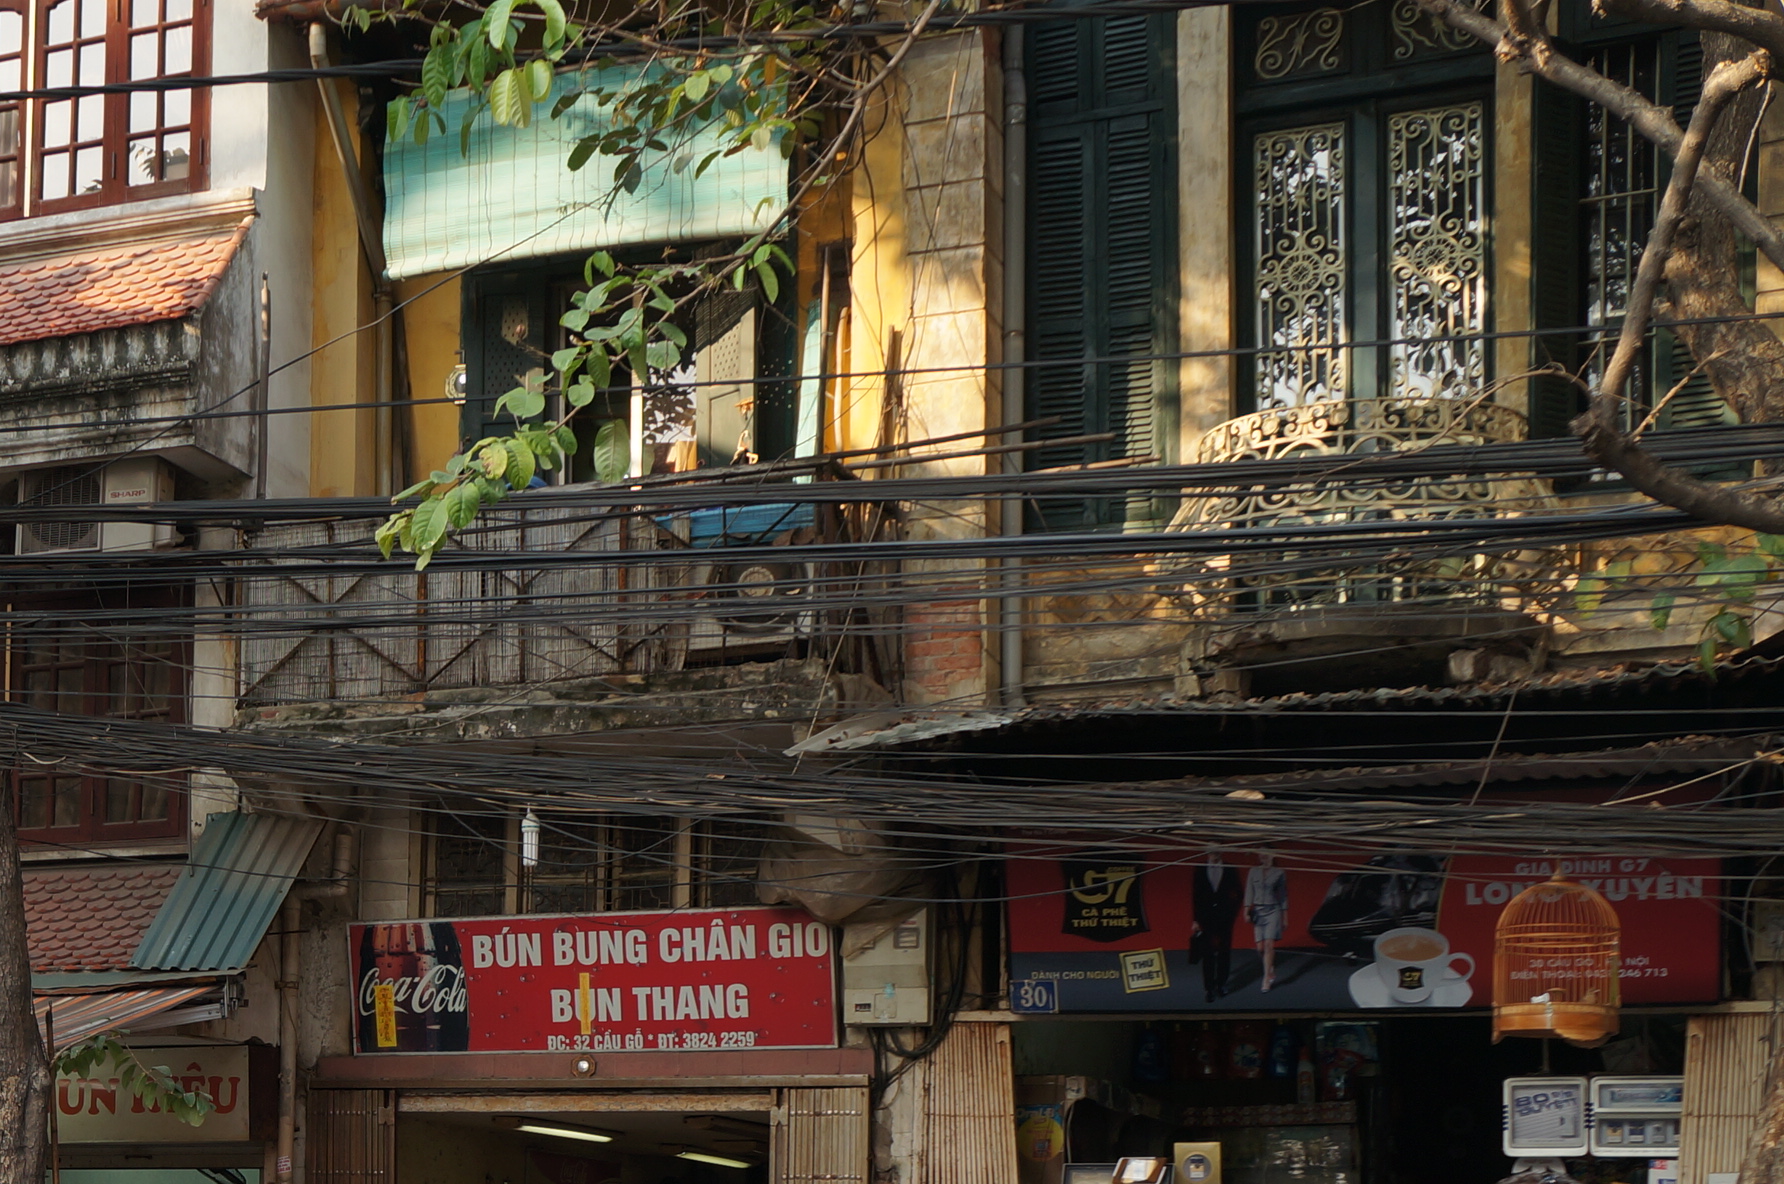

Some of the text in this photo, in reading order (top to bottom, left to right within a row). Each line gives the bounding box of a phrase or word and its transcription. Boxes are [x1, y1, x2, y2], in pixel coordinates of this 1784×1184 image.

[109, 489, 147, 501] SHARP
[1516, 862, 1553, 875] GIA
[1619, 858, 1651, 872] G7
[1082, 905, 1099, 917] CÀ
[472, 918, 829, 969] BÚN BUNG CHÂN GIO
[1644, 966, 1668, 978] 713
[358, 963, 467, 1017] Coa-Cola
[1020, 985, 1048, 1008] 30
[632, 983, 749, 1021] THANG
[548, 1027, 755, 1050] ĐC: 32 CẦU GỖ ĐT: 3824 2259
